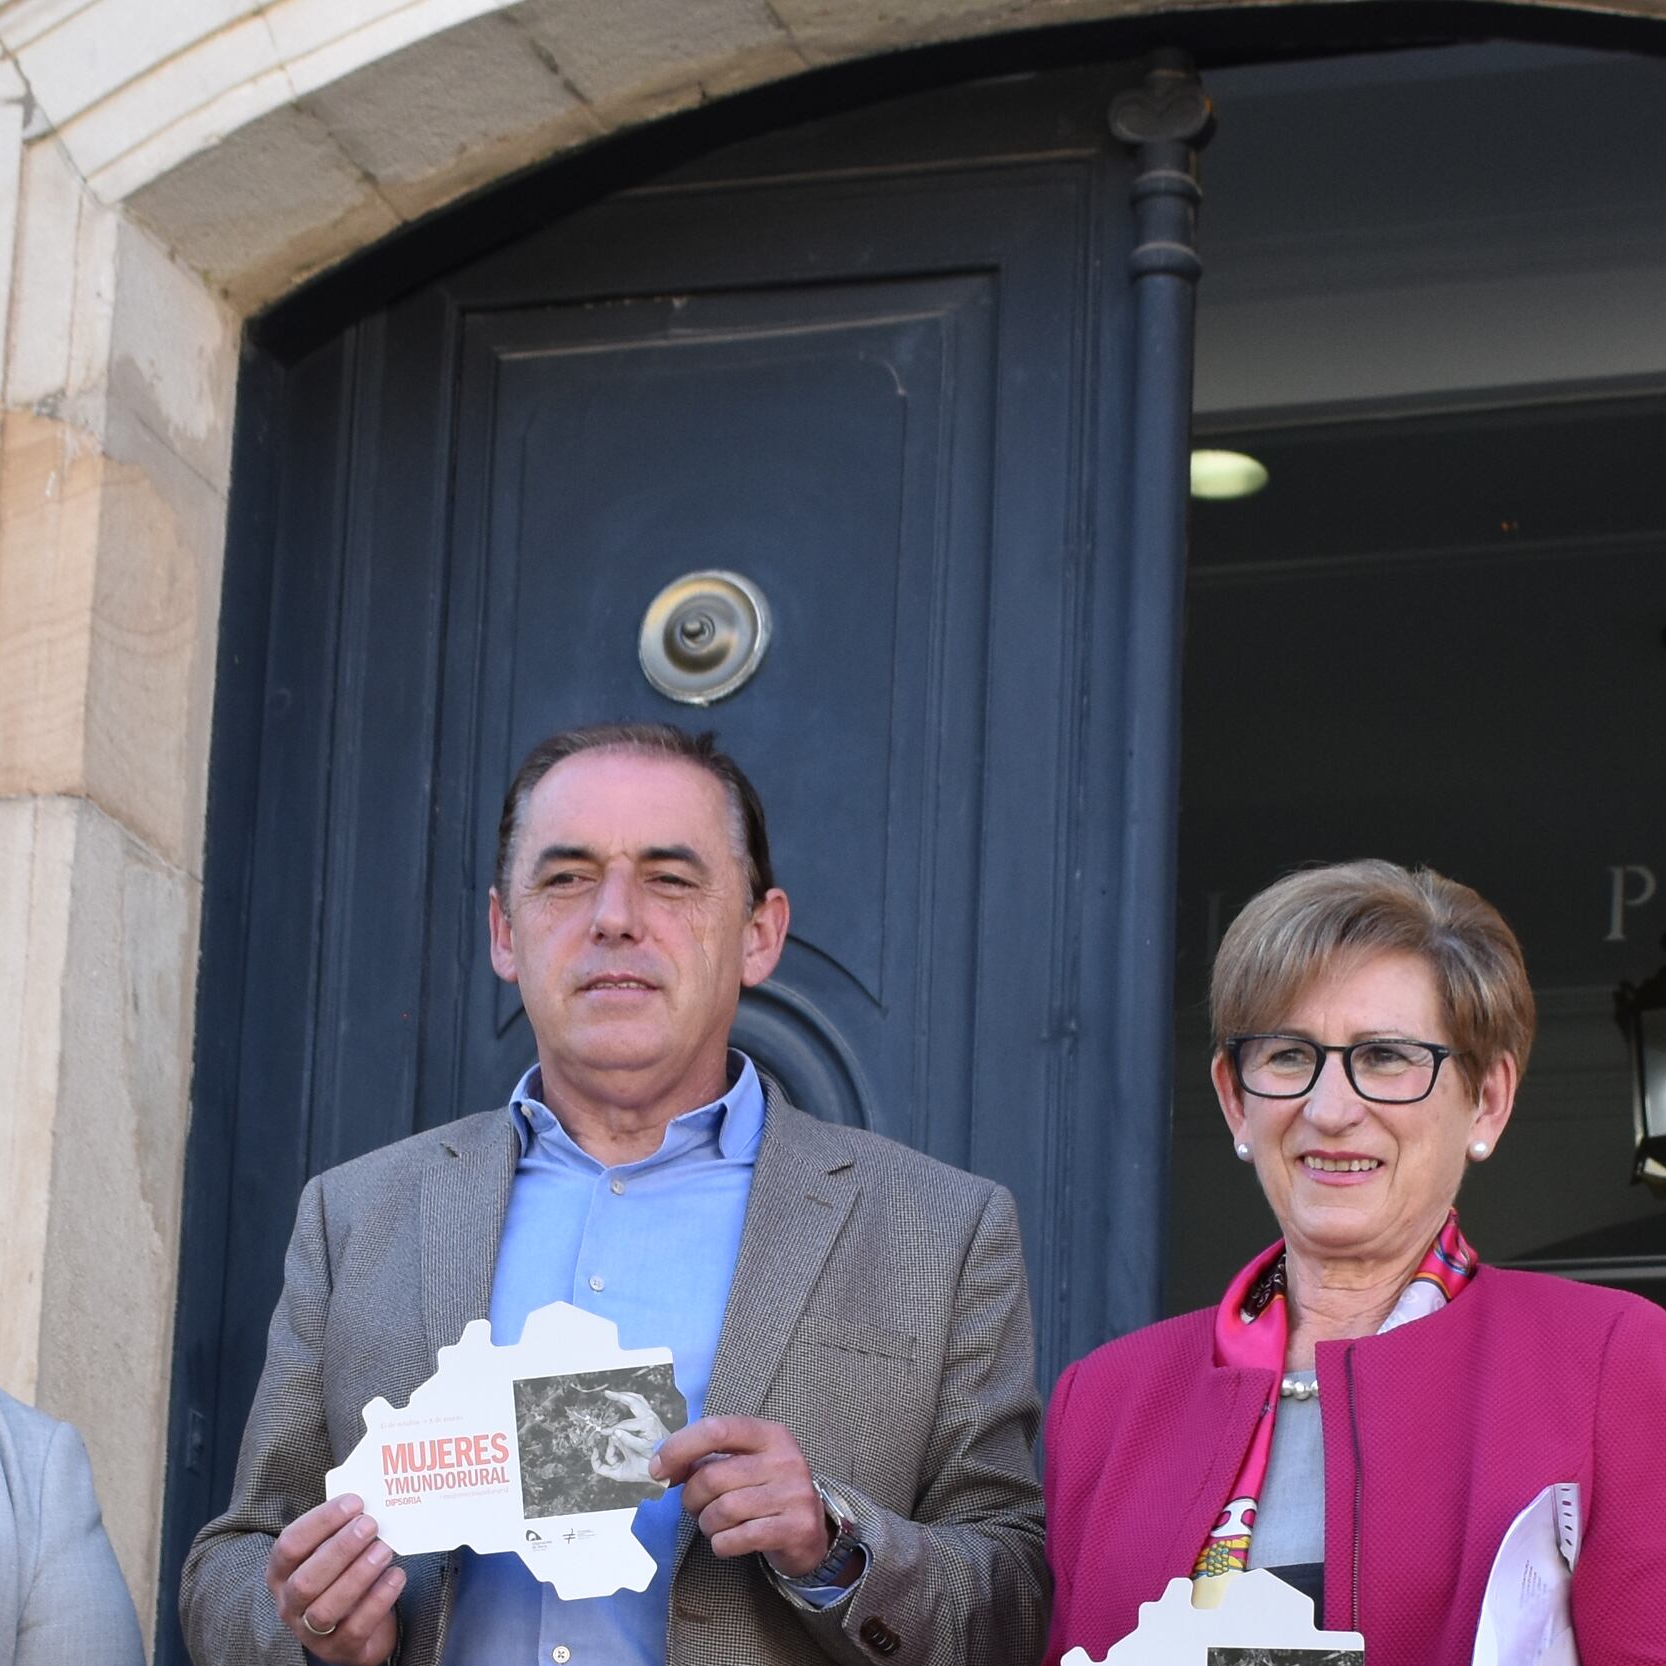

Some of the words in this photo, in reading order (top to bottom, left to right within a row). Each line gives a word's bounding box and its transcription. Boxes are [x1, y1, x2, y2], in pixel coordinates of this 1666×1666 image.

[381, 1432, 510, 1475] MUJERES
[384, 1466, 510, 1495] YMUNDORURAL
[385, 1495, 422, 1507] DIPSORIA
